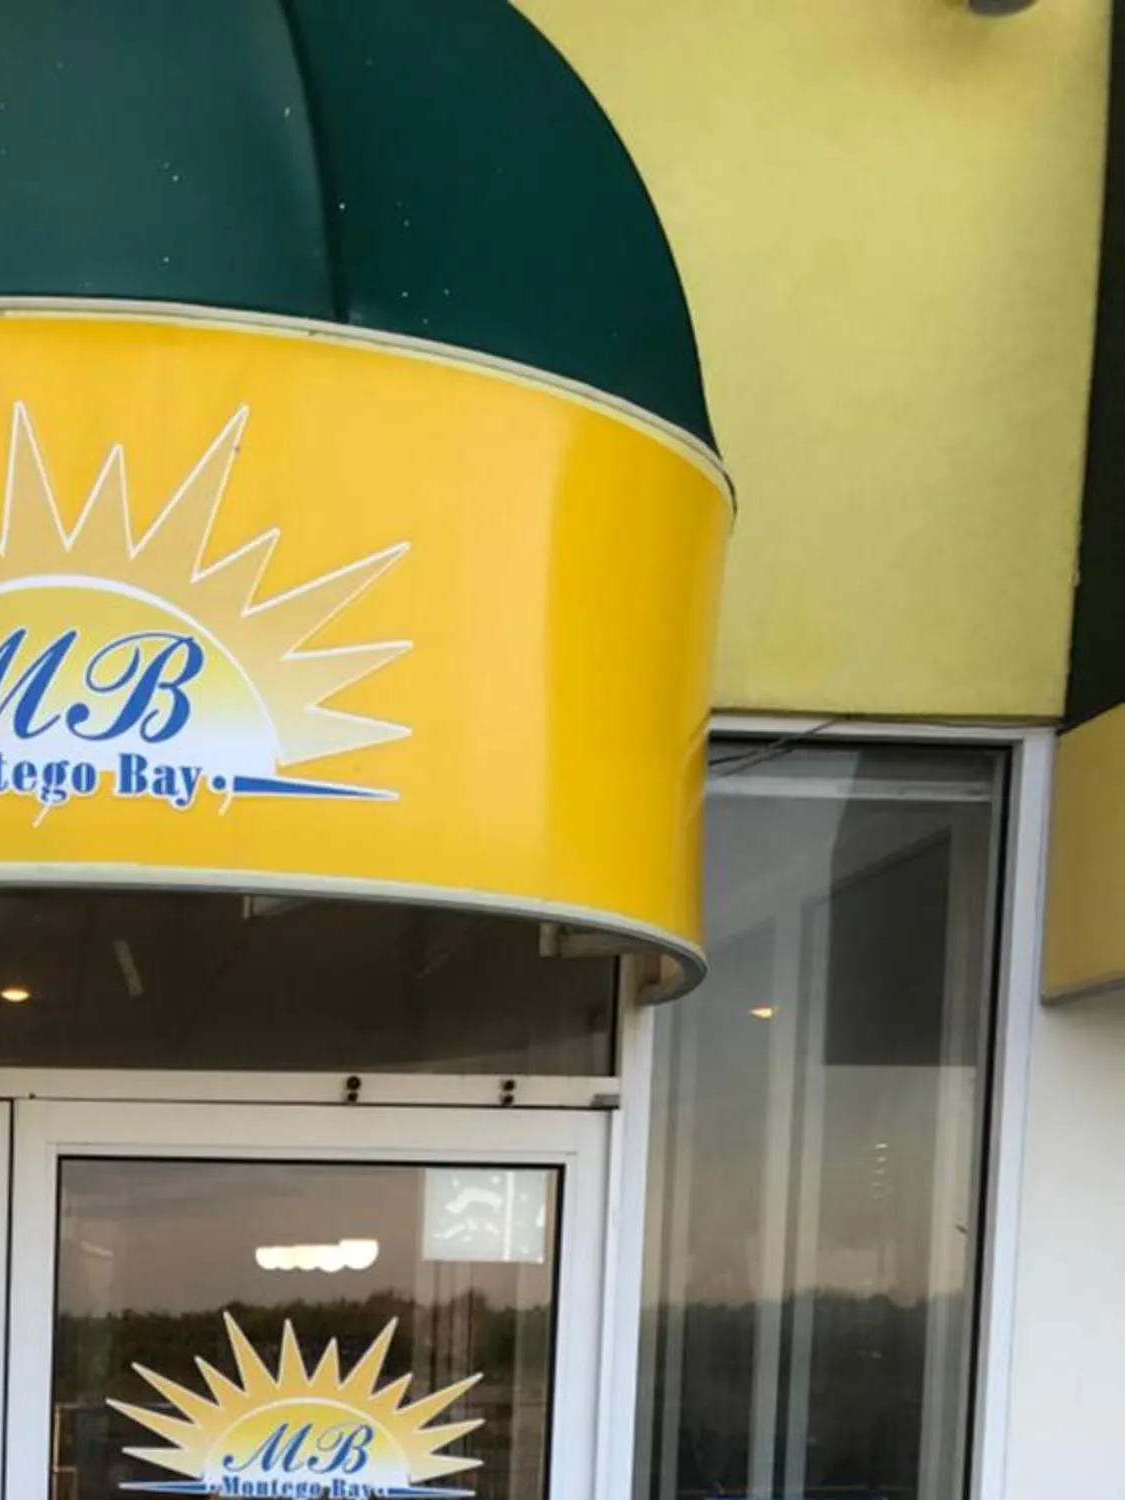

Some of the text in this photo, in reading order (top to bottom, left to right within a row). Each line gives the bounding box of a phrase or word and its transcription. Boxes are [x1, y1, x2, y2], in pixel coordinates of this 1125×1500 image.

[117, 754, 202, 806] Bay
[223, 1422, 374, 1474] MB
[223, 1476, 321, 1500] Montego
